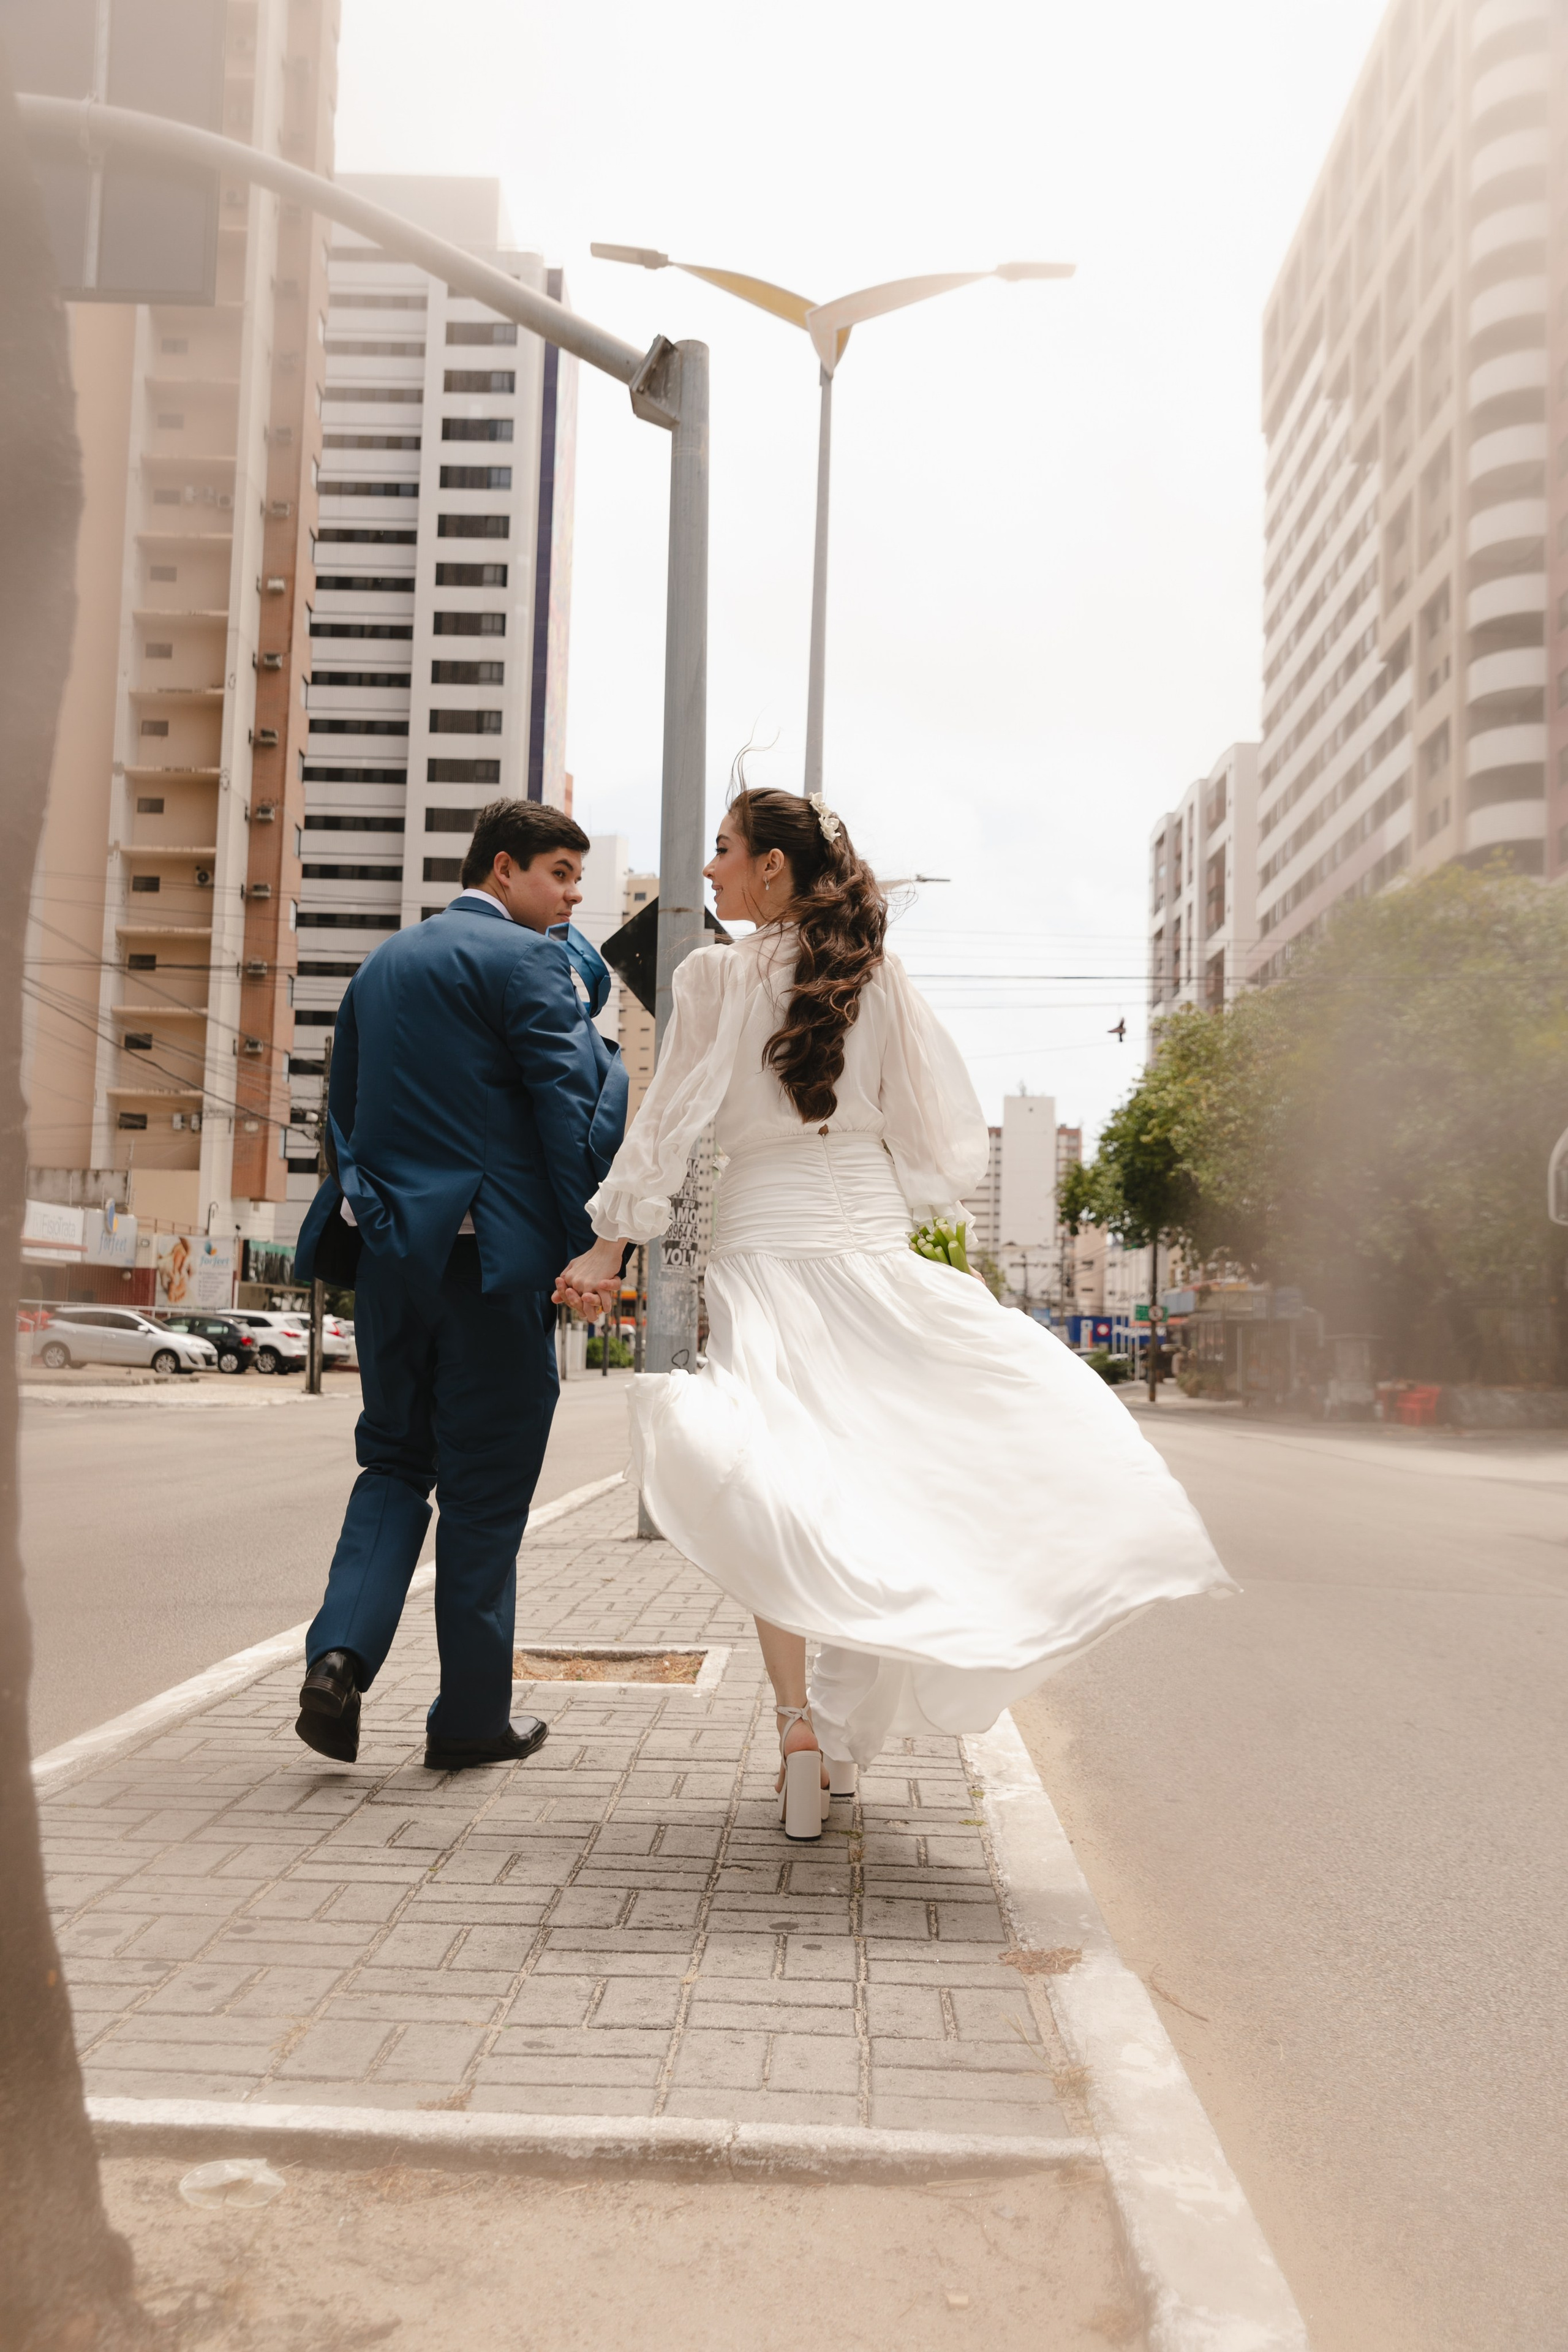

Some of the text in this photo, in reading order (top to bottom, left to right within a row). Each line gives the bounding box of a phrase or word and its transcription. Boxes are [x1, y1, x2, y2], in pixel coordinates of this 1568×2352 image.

[681, 1200, 695, 1208] SEU
[668, 1206, 698, 1224] AMO
[679, 1241, 693, 1250] DE
[662, 1248, 698, 1267] VOLT
